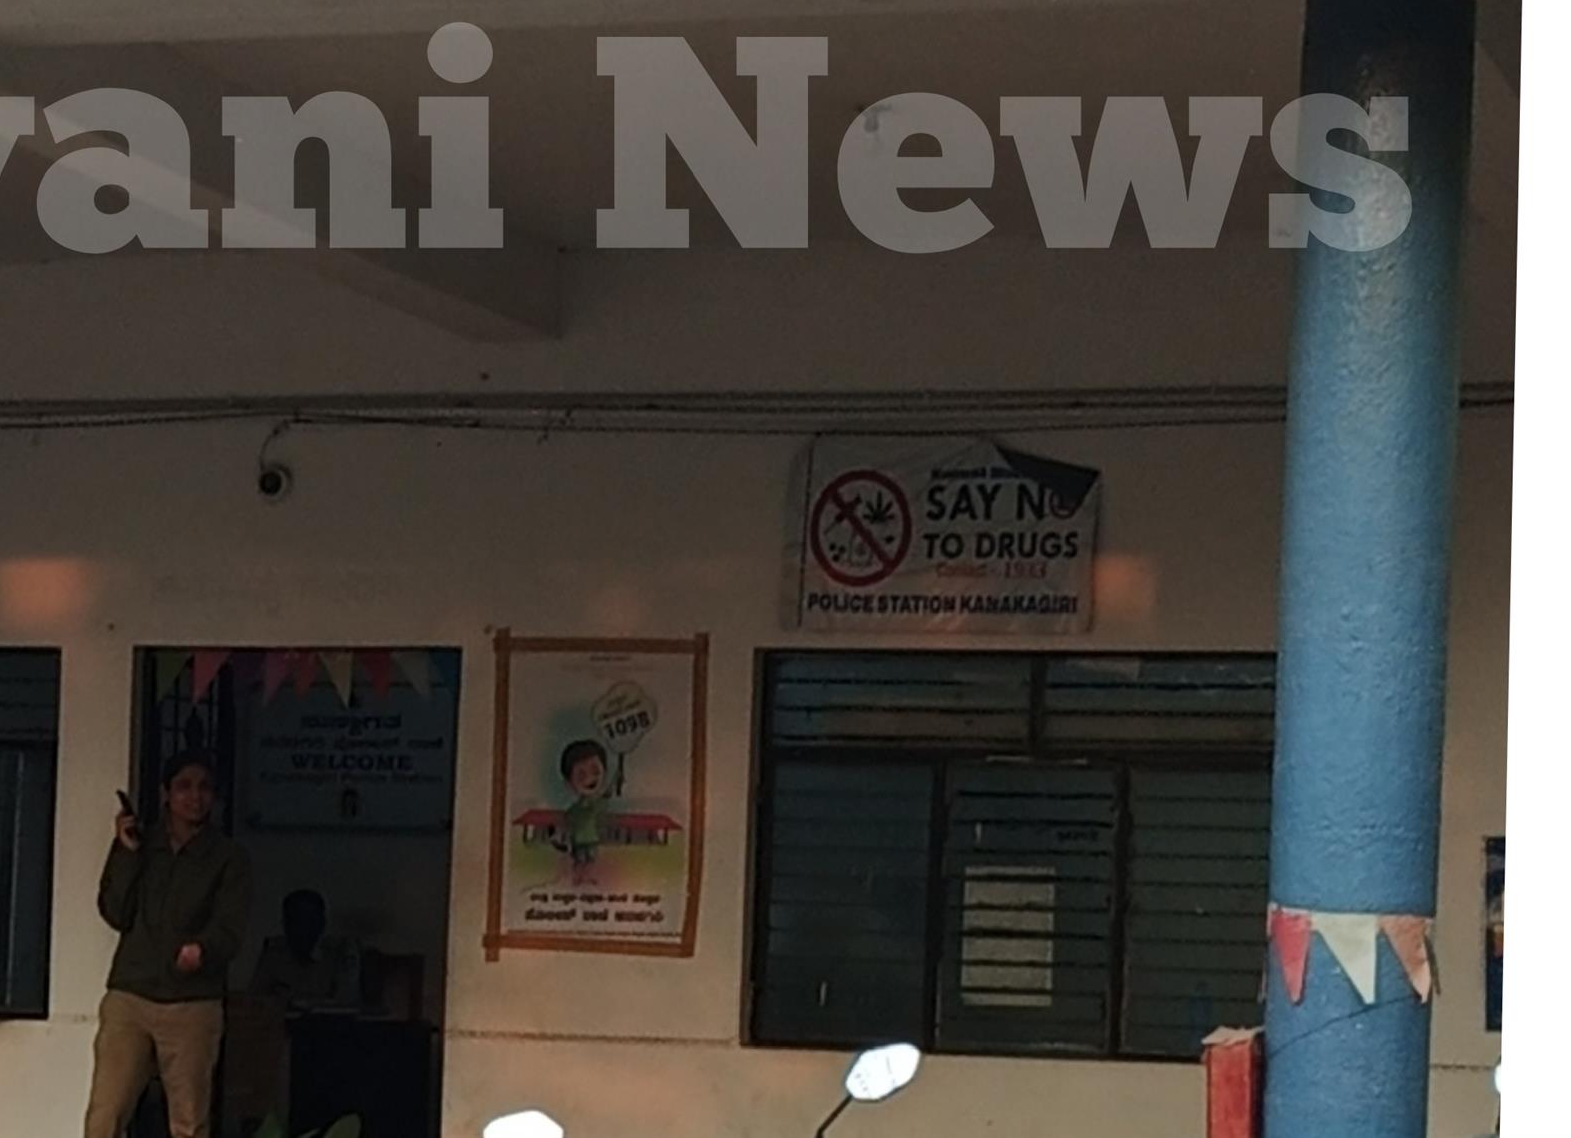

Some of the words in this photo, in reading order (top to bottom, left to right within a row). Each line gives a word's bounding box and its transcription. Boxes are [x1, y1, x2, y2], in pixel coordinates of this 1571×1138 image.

[927, 484, 1003, 520] SAY
[923, 533, 964, 559] TO
[975, 532, 1079, 559] DRUGS
[807, 593, 873, 612] POLICE
[878, 594, 956, 613] STATION
[960, 595, 1077, 614] KANAKAGIRI
[605, 711, 650, 739] 1098
[291, 753, 414, 771] WELCOME
